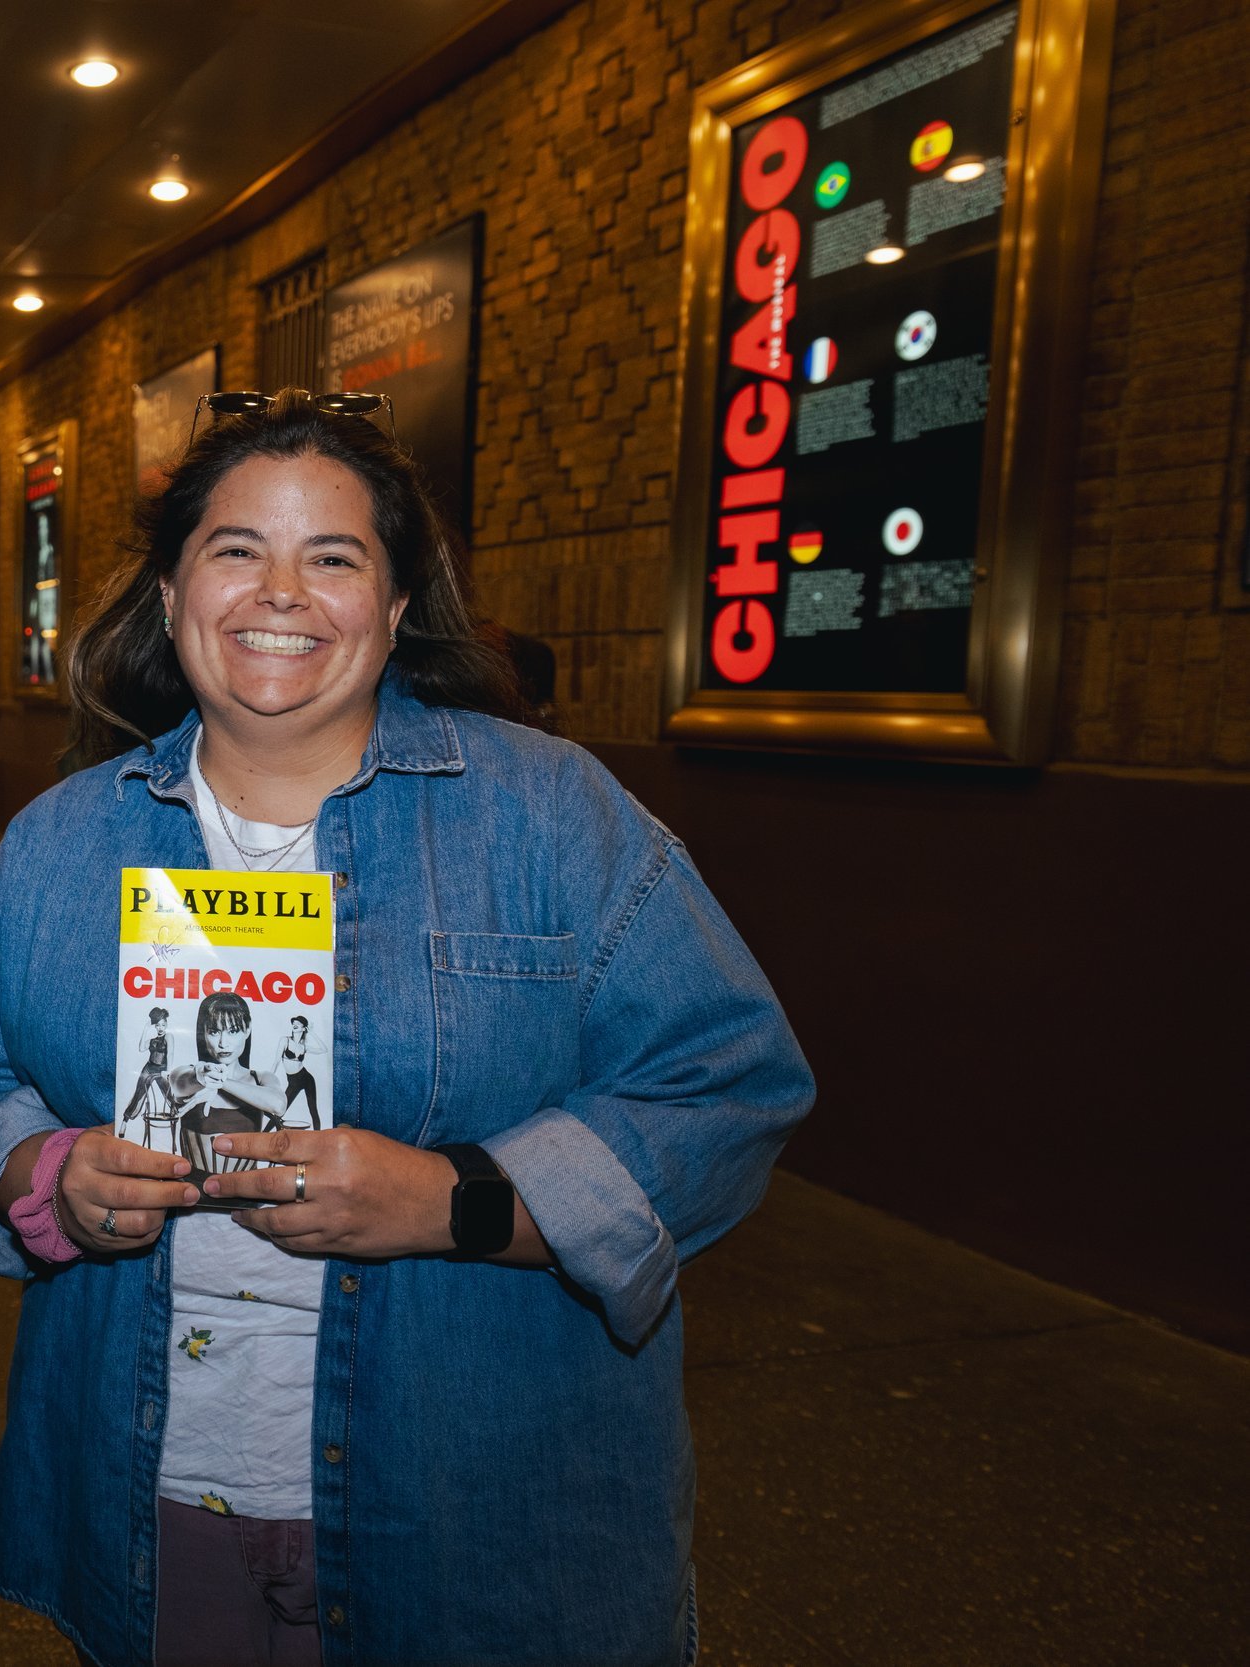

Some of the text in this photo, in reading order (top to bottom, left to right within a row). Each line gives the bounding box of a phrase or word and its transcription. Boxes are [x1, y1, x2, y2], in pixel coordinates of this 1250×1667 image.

[331, 265, 433, 337] THE NAME ON
[423, 291, 454, 329] LIPS
[711, 117, 808, 684] CHICAGO
[129, 887, 320, 918] PLAYBILL
[184, 924, 264, 934] AMBASSADOR THEATRE
[123, 966, 326, 1006] CHICAGO
